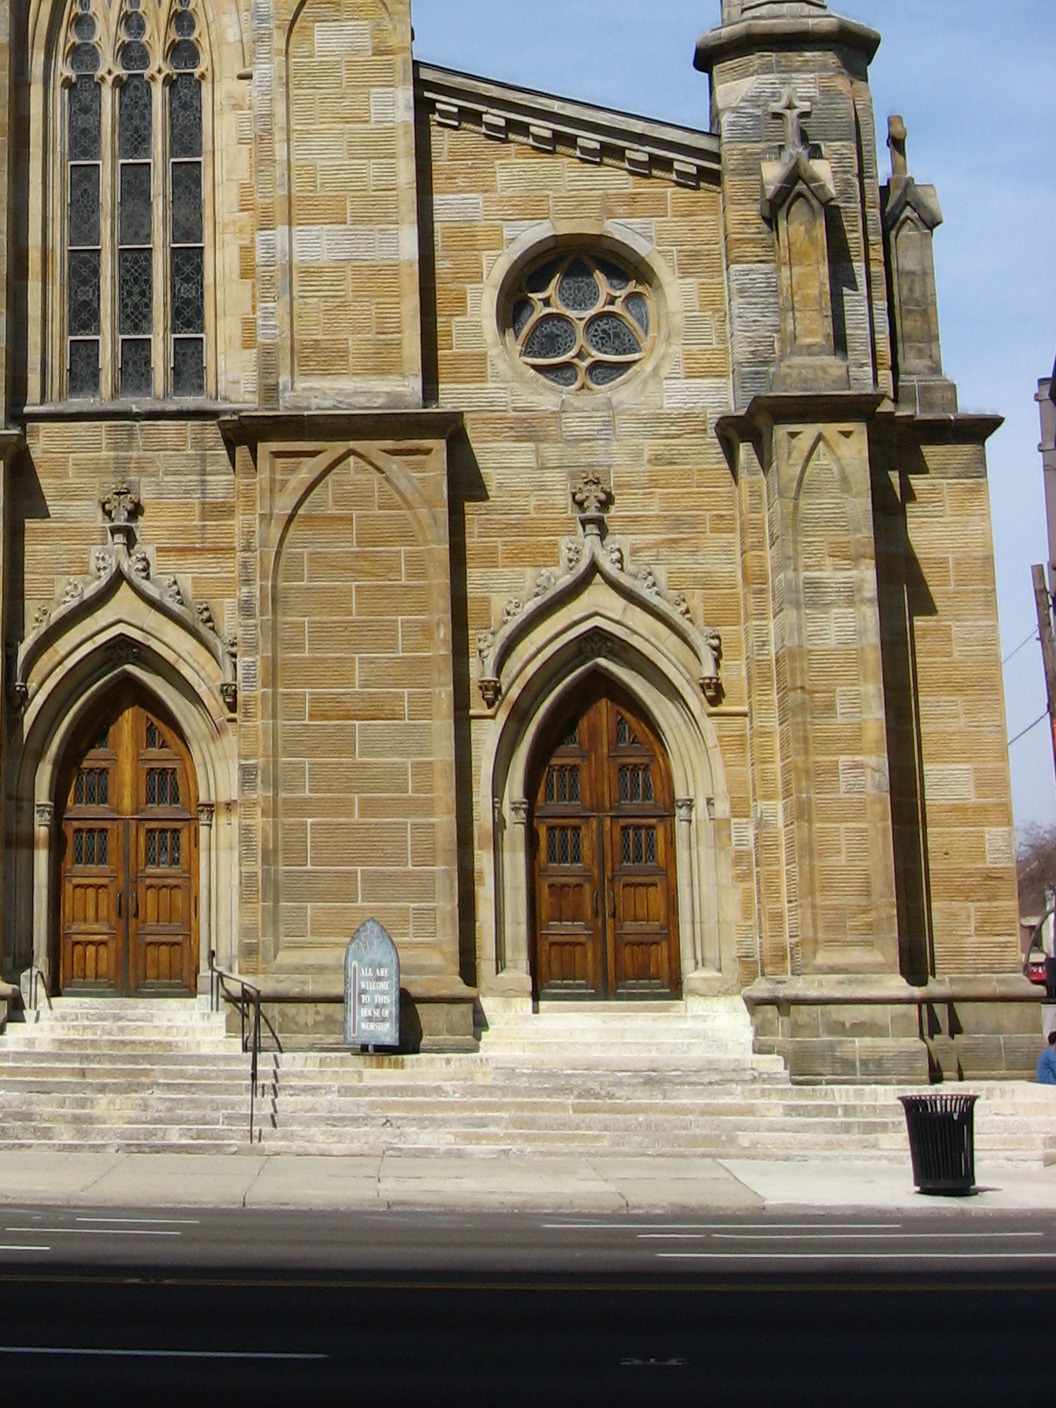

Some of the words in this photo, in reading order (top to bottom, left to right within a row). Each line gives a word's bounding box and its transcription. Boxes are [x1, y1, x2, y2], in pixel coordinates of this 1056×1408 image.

[360, 967, 373, 977] ALL
[376, 967, 389, 977] ARE
[360, 981, 390, 990] WELCOME
[361, 994, 371, 1004] TO
[374, 994, 391, 1004] THIS
[360, 1008, 380, 1017] HOUSE
[360, 1022, 390, 1031] WORSHIP
